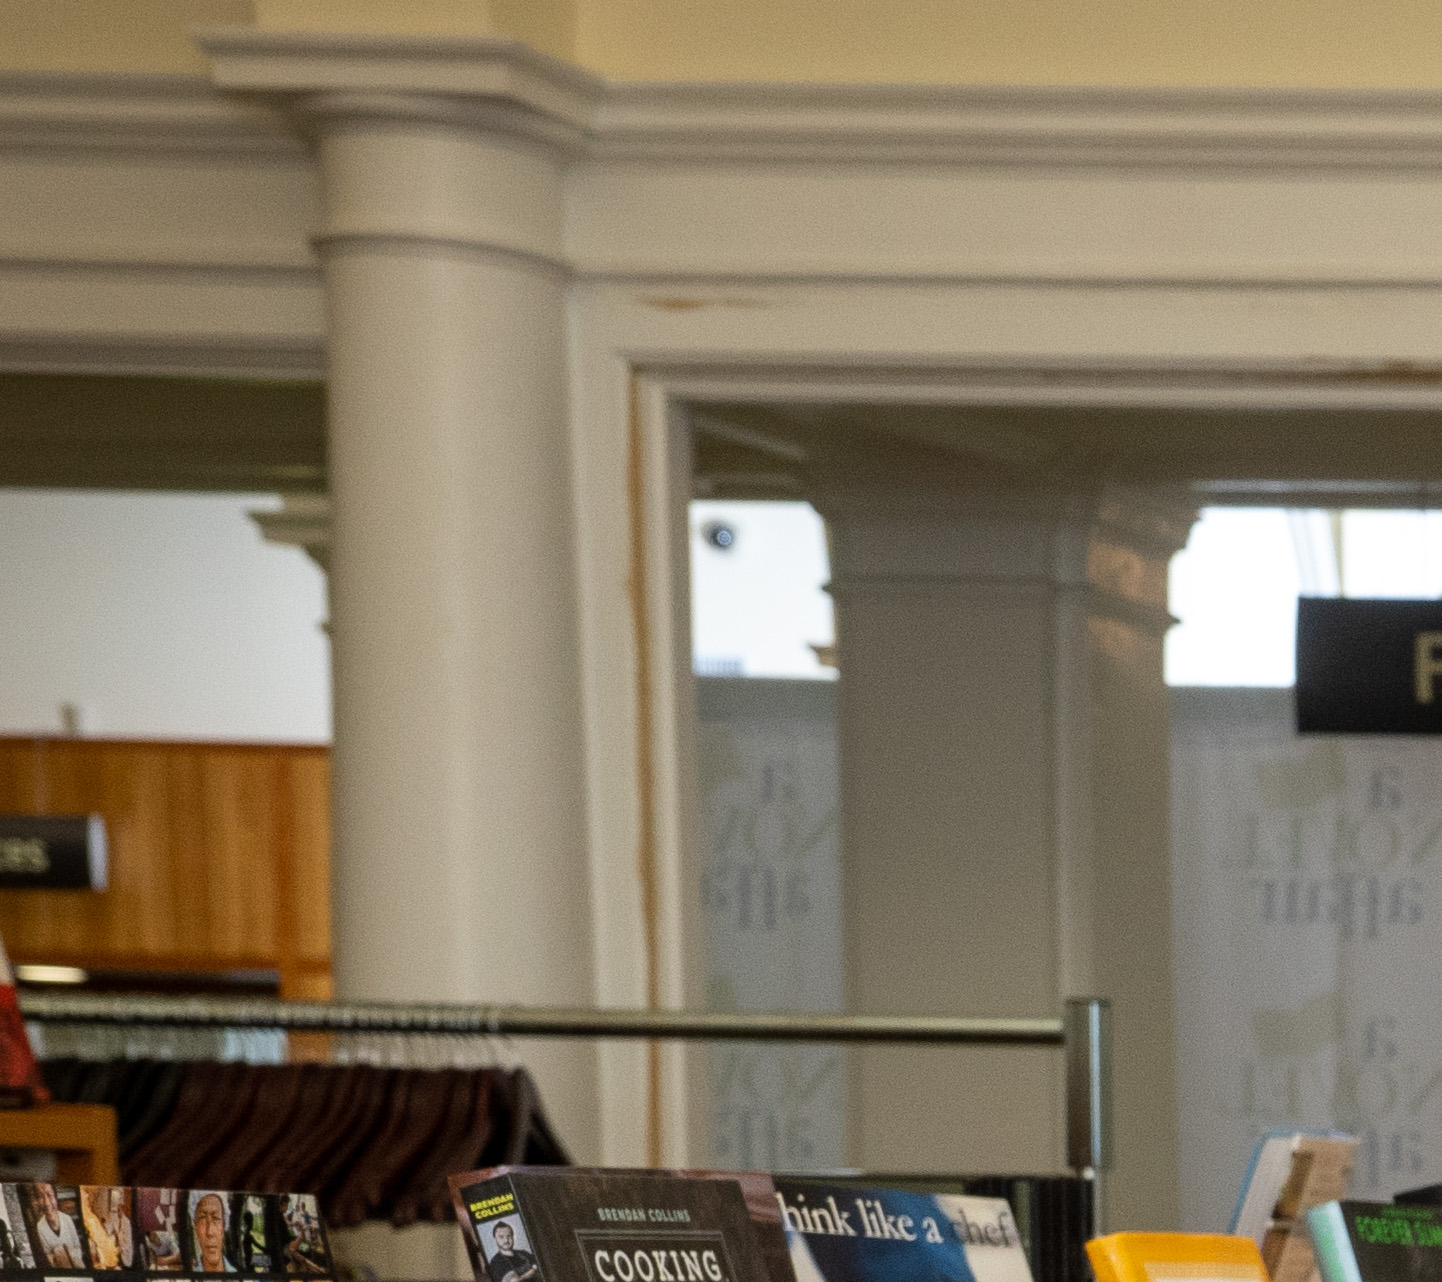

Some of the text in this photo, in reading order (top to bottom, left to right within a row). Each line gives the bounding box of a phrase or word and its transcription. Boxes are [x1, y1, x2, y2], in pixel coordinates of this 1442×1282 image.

[597, 1208, 690, 1223] BRENDAN COLLINS
[859, 1198, 917, 1242] like
[922, 1217, 944, 1244] a
[950, 1211, 1015, 1251] chef
